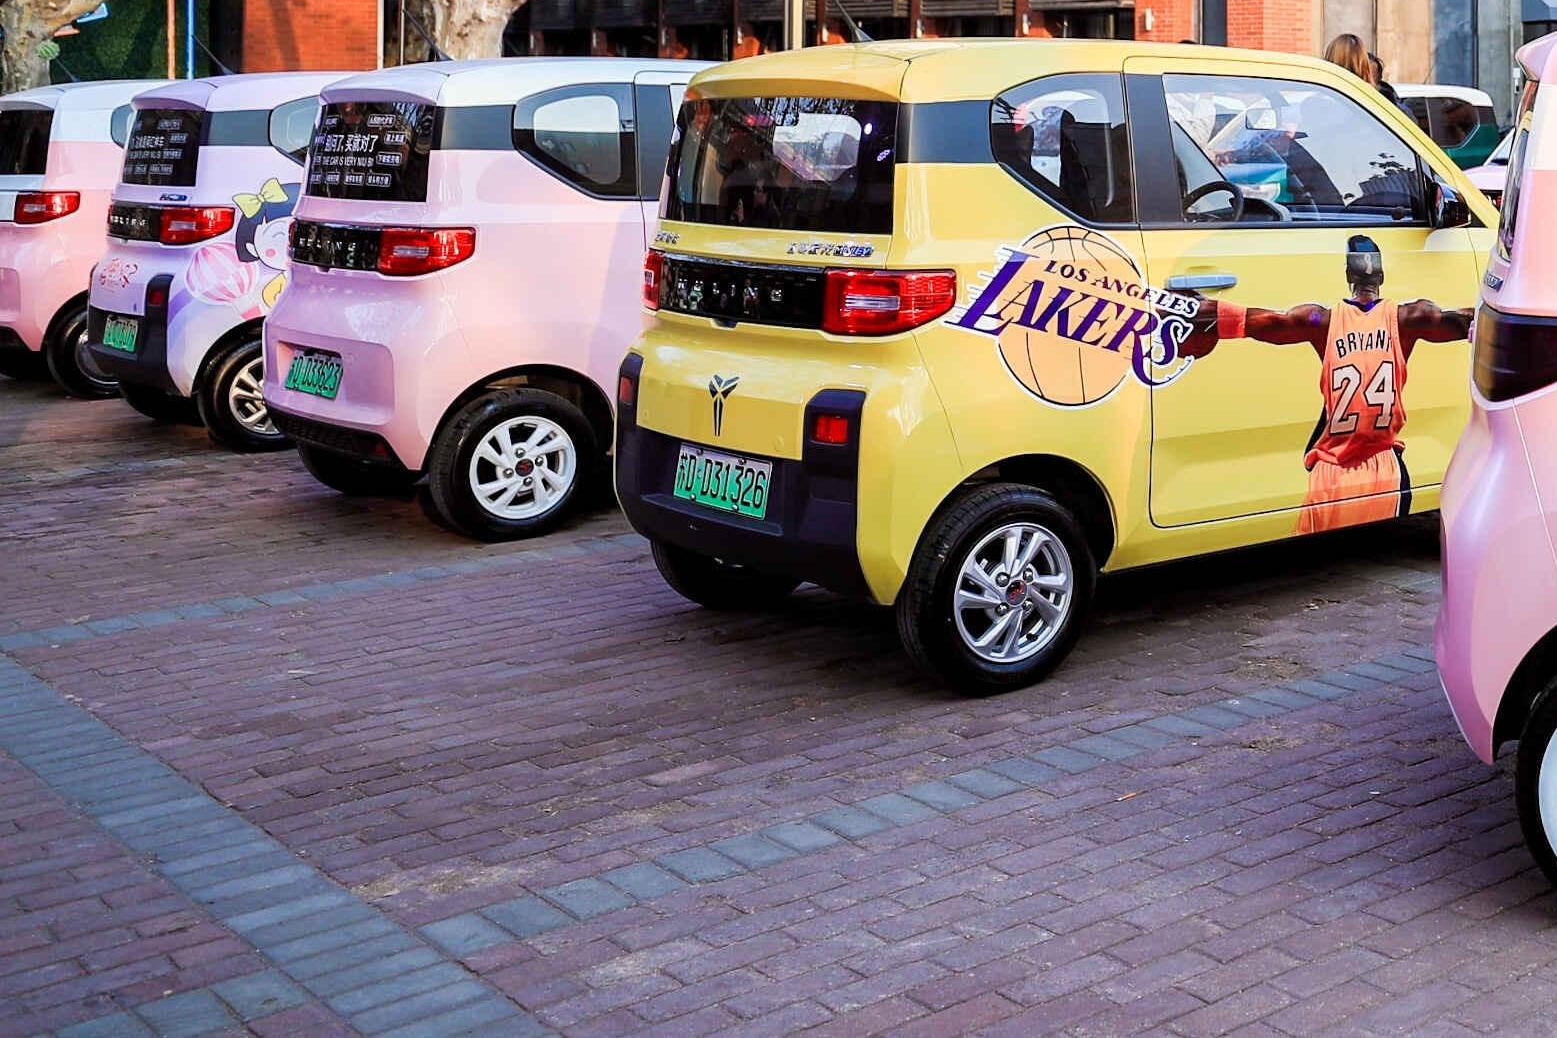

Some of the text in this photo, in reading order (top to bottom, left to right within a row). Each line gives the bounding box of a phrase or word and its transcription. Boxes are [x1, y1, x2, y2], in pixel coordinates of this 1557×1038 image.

[944, 247, 1194, 386] LAKERS
[1044, 260, 1198, 315] LOS ANGELES
[1329, 360, 1397, 436] 24
